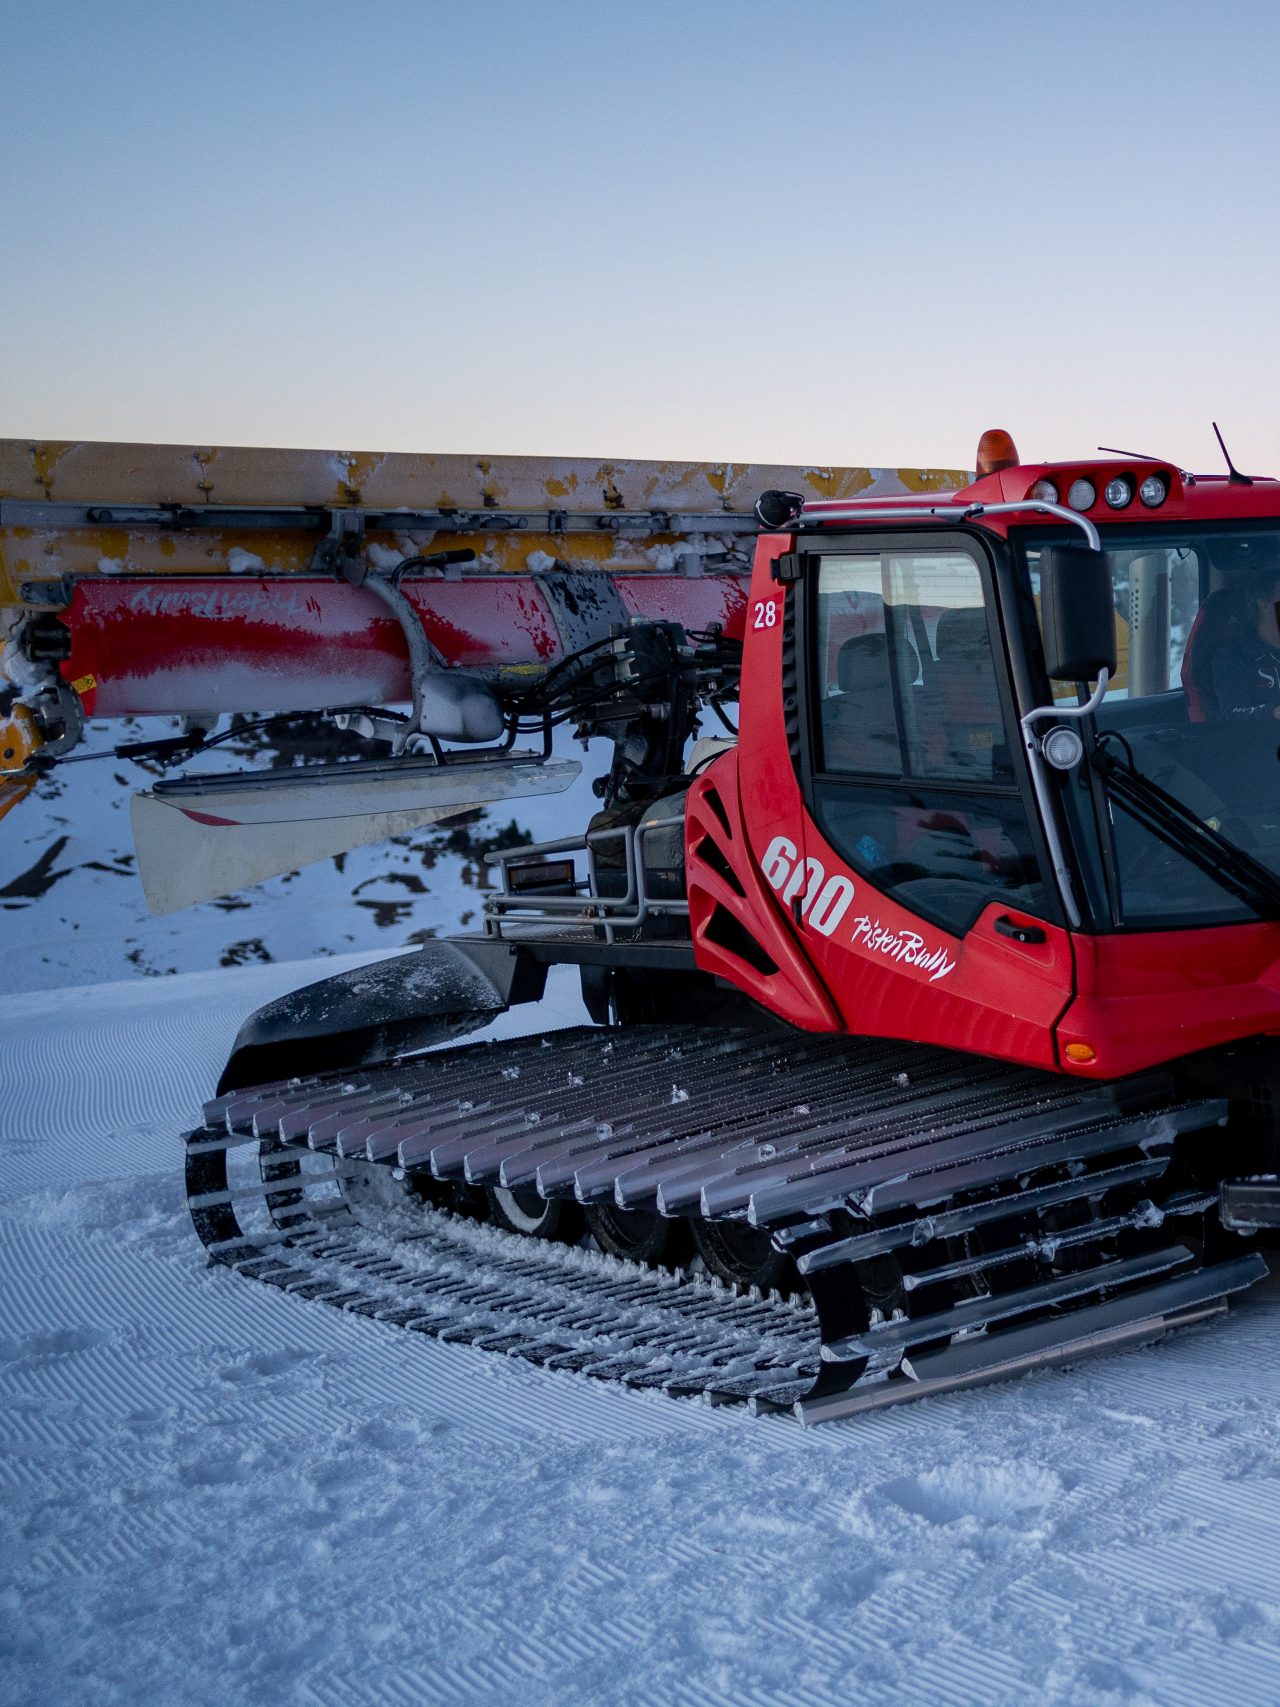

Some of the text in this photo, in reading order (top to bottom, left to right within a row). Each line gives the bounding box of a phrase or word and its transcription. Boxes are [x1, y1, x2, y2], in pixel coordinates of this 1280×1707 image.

[754, 600, 776, 629] 28
[761, 836, 855, 937] 600
[851, 915, 956, 982] PistenBully
